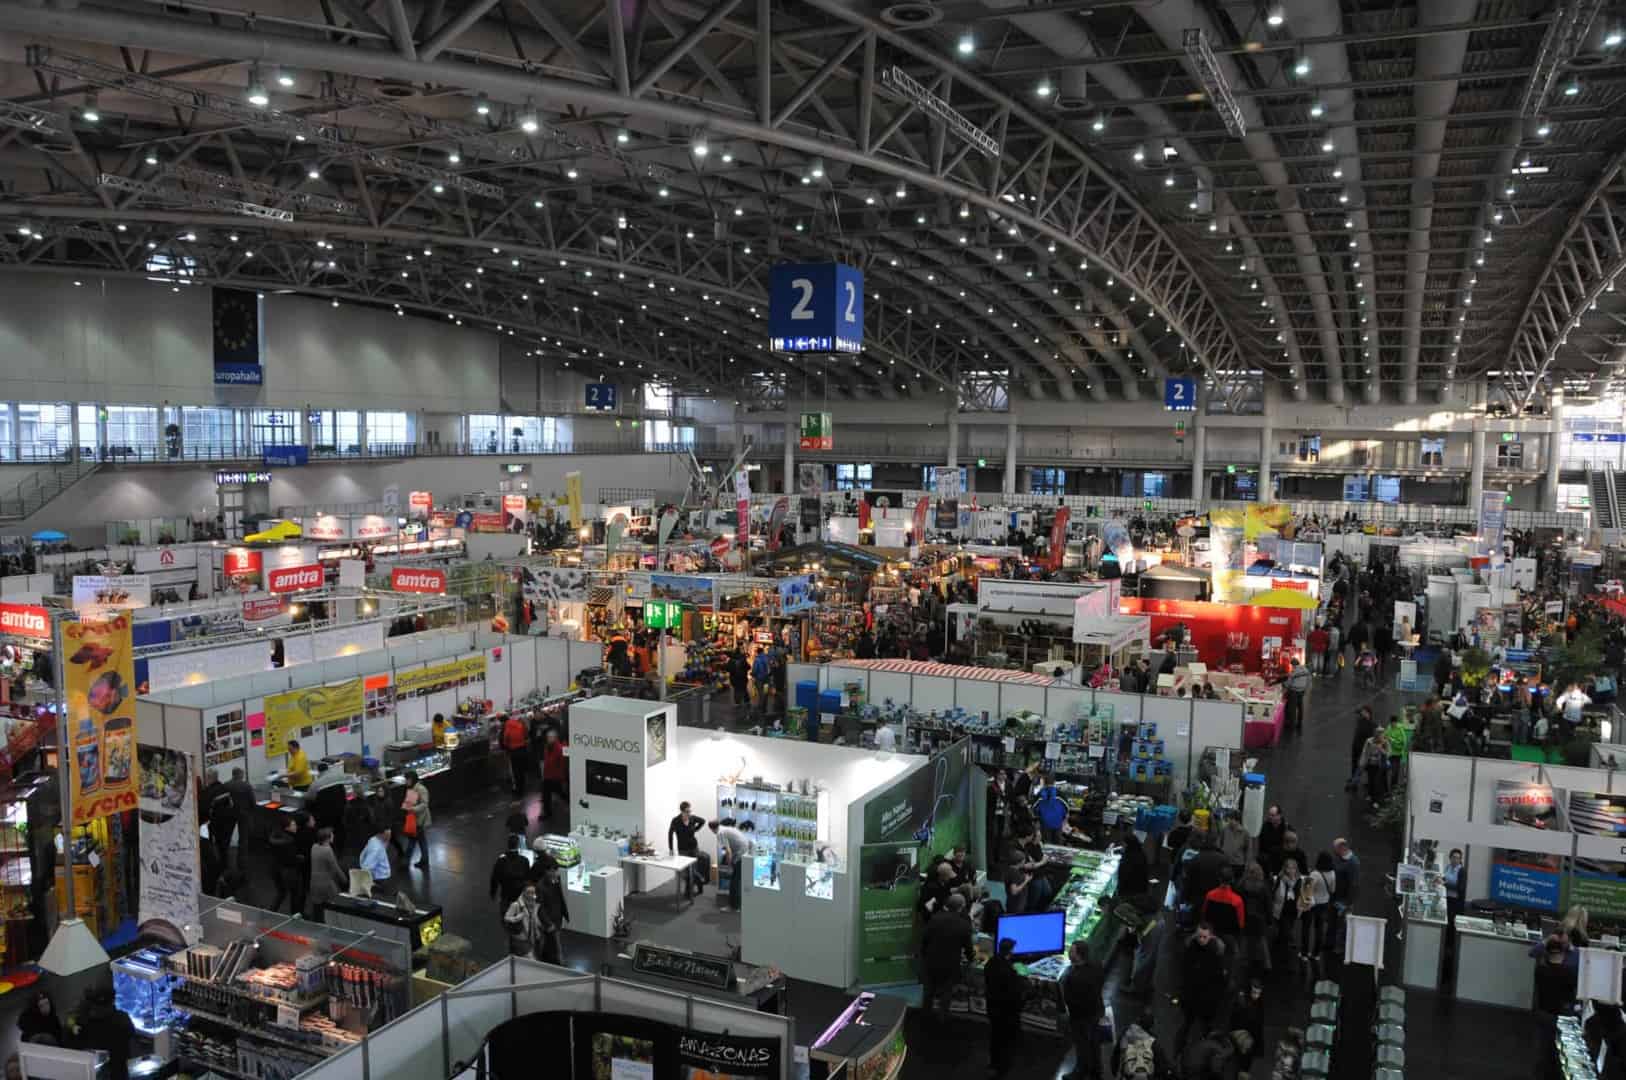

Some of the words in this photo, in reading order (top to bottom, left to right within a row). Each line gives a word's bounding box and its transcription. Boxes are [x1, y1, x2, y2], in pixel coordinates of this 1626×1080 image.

[791, 278, 815, 320] 2
[845, 281, 855, 322] 2
[591, 387, 599, 401] 2
[1174, 383, 1185, 400] 2
[274, 569, 319, 588] amtra
[396, 573, 441, 589] amtra
[1, 610, 45, 631] amtra
[680, 1036, 771, 1063] AMAZONAS
